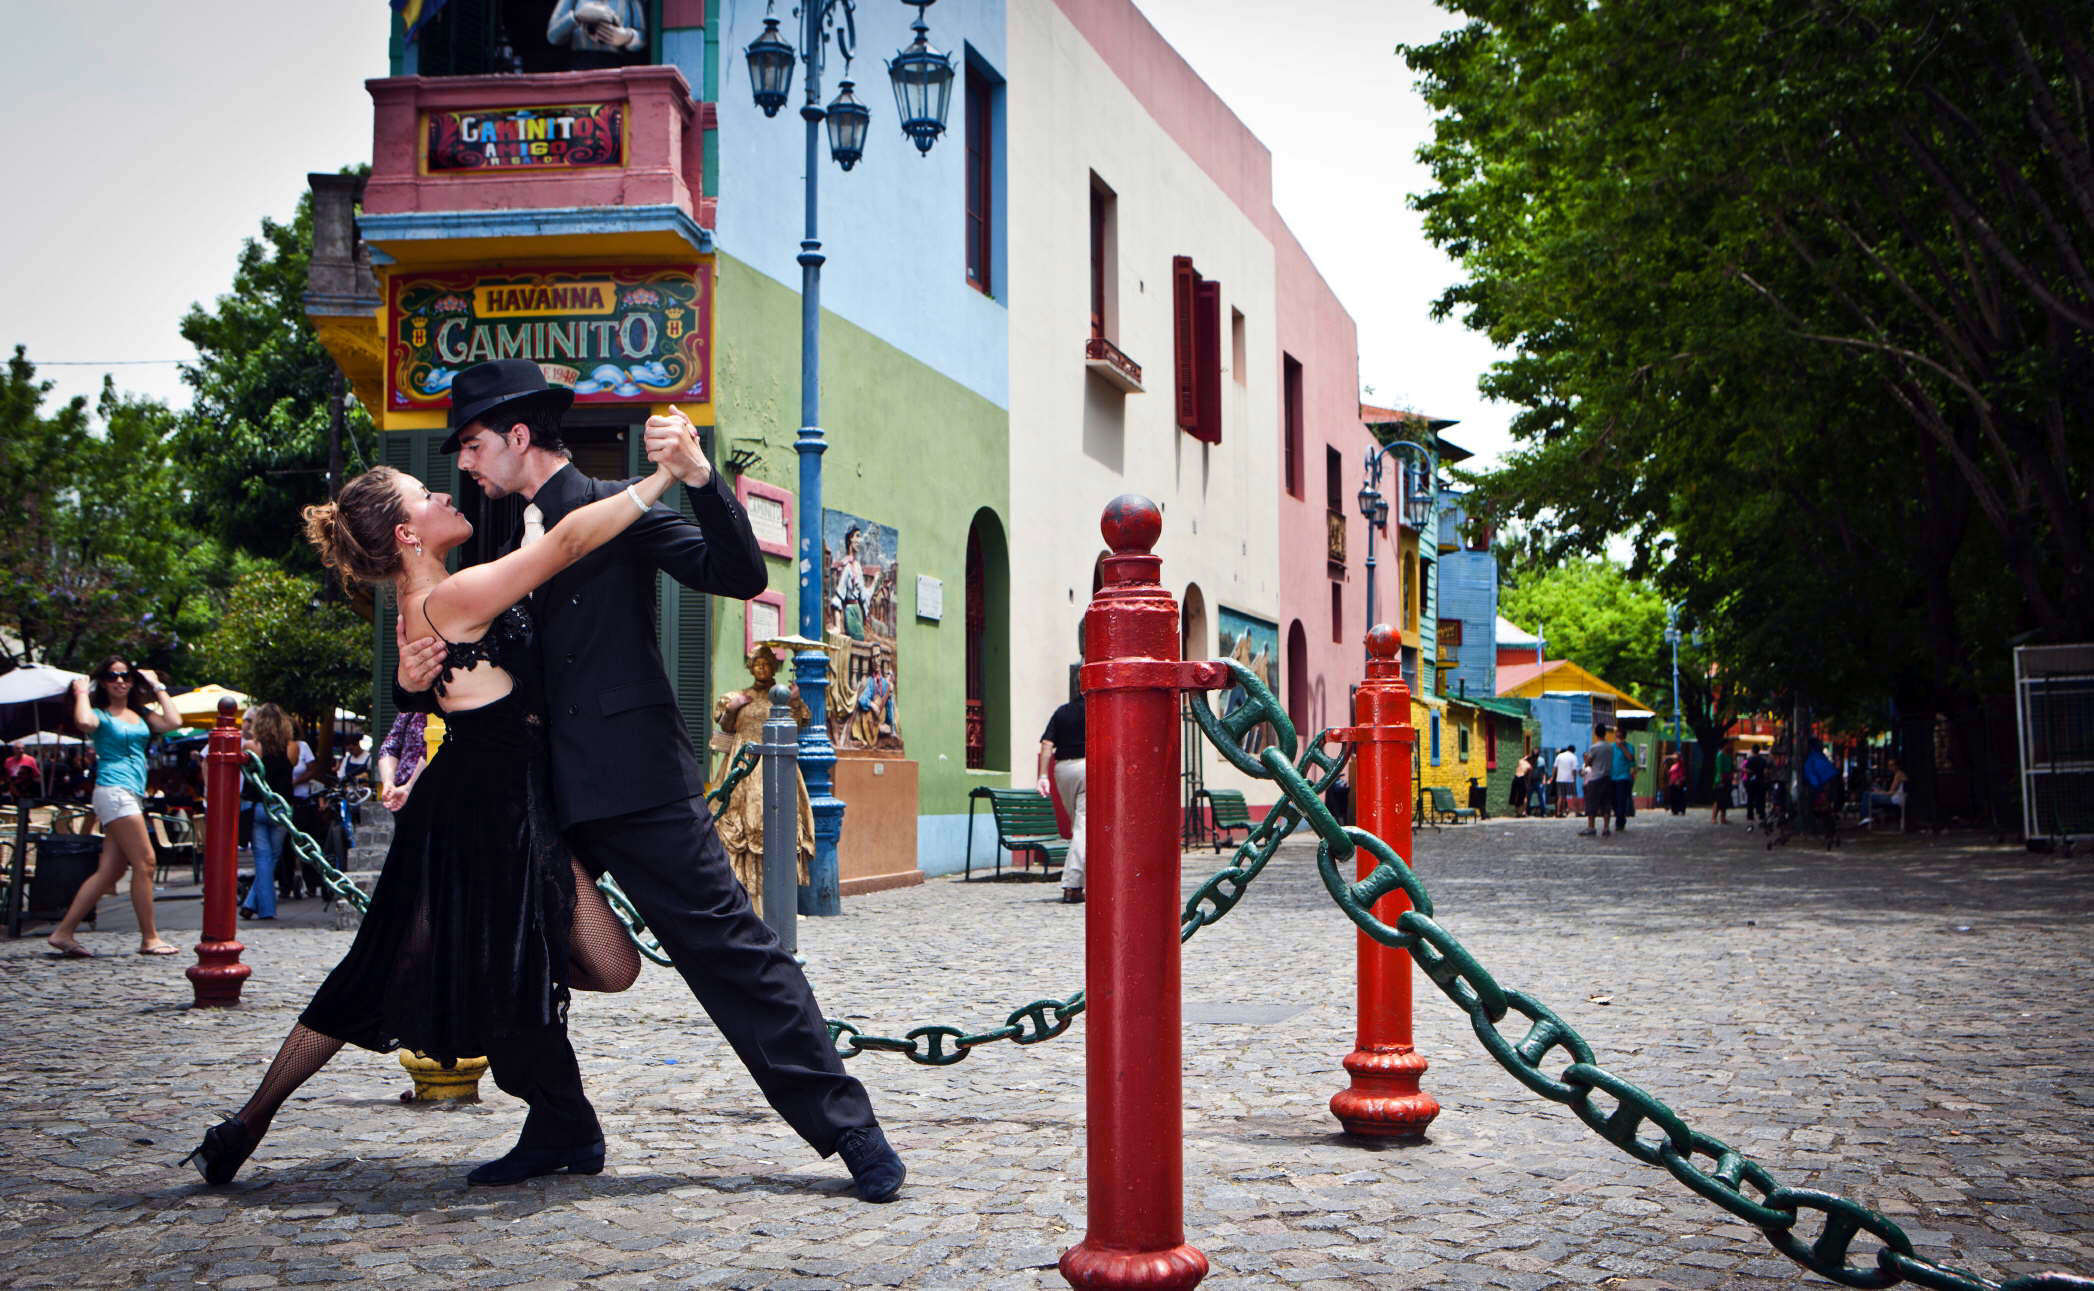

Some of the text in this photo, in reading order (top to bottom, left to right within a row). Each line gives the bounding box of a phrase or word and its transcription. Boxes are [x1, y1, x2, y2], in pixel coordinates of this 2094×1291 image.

[461, 116, 594, 142] CAMINITO
[485, 141, 568, 157] AMIGO
[487, 287, 605, 311] HAVANNA
[436, 312, 659, 364] CAMINITO
[553, 368, 576, 384] 1948
